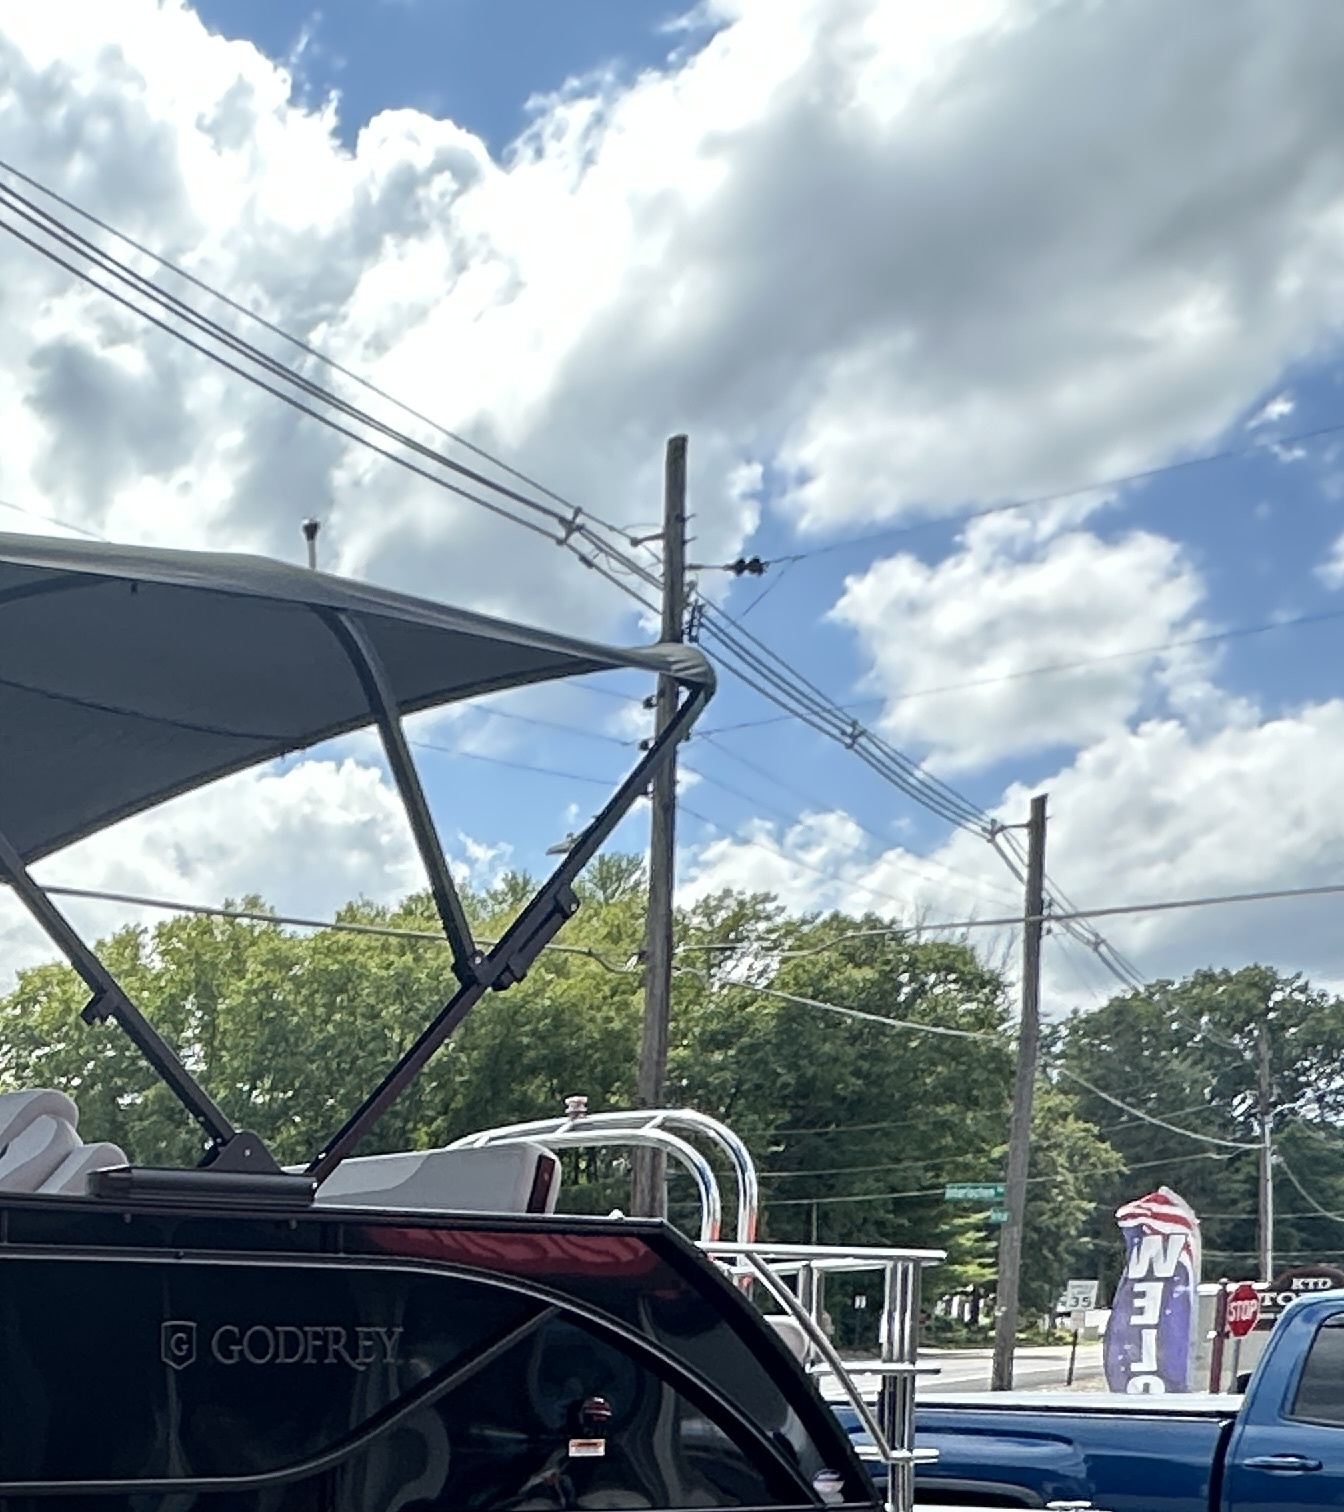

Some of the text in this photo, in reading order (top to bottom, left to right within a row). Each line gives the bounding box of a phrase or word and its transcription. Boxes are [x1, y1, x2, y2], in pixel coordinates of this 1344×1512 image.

[1069, 1297, 1091, 1308] 35
[1227, 1300, 1258, 1321] STOP
[211, 1324, 405, 1372] GODFREY
